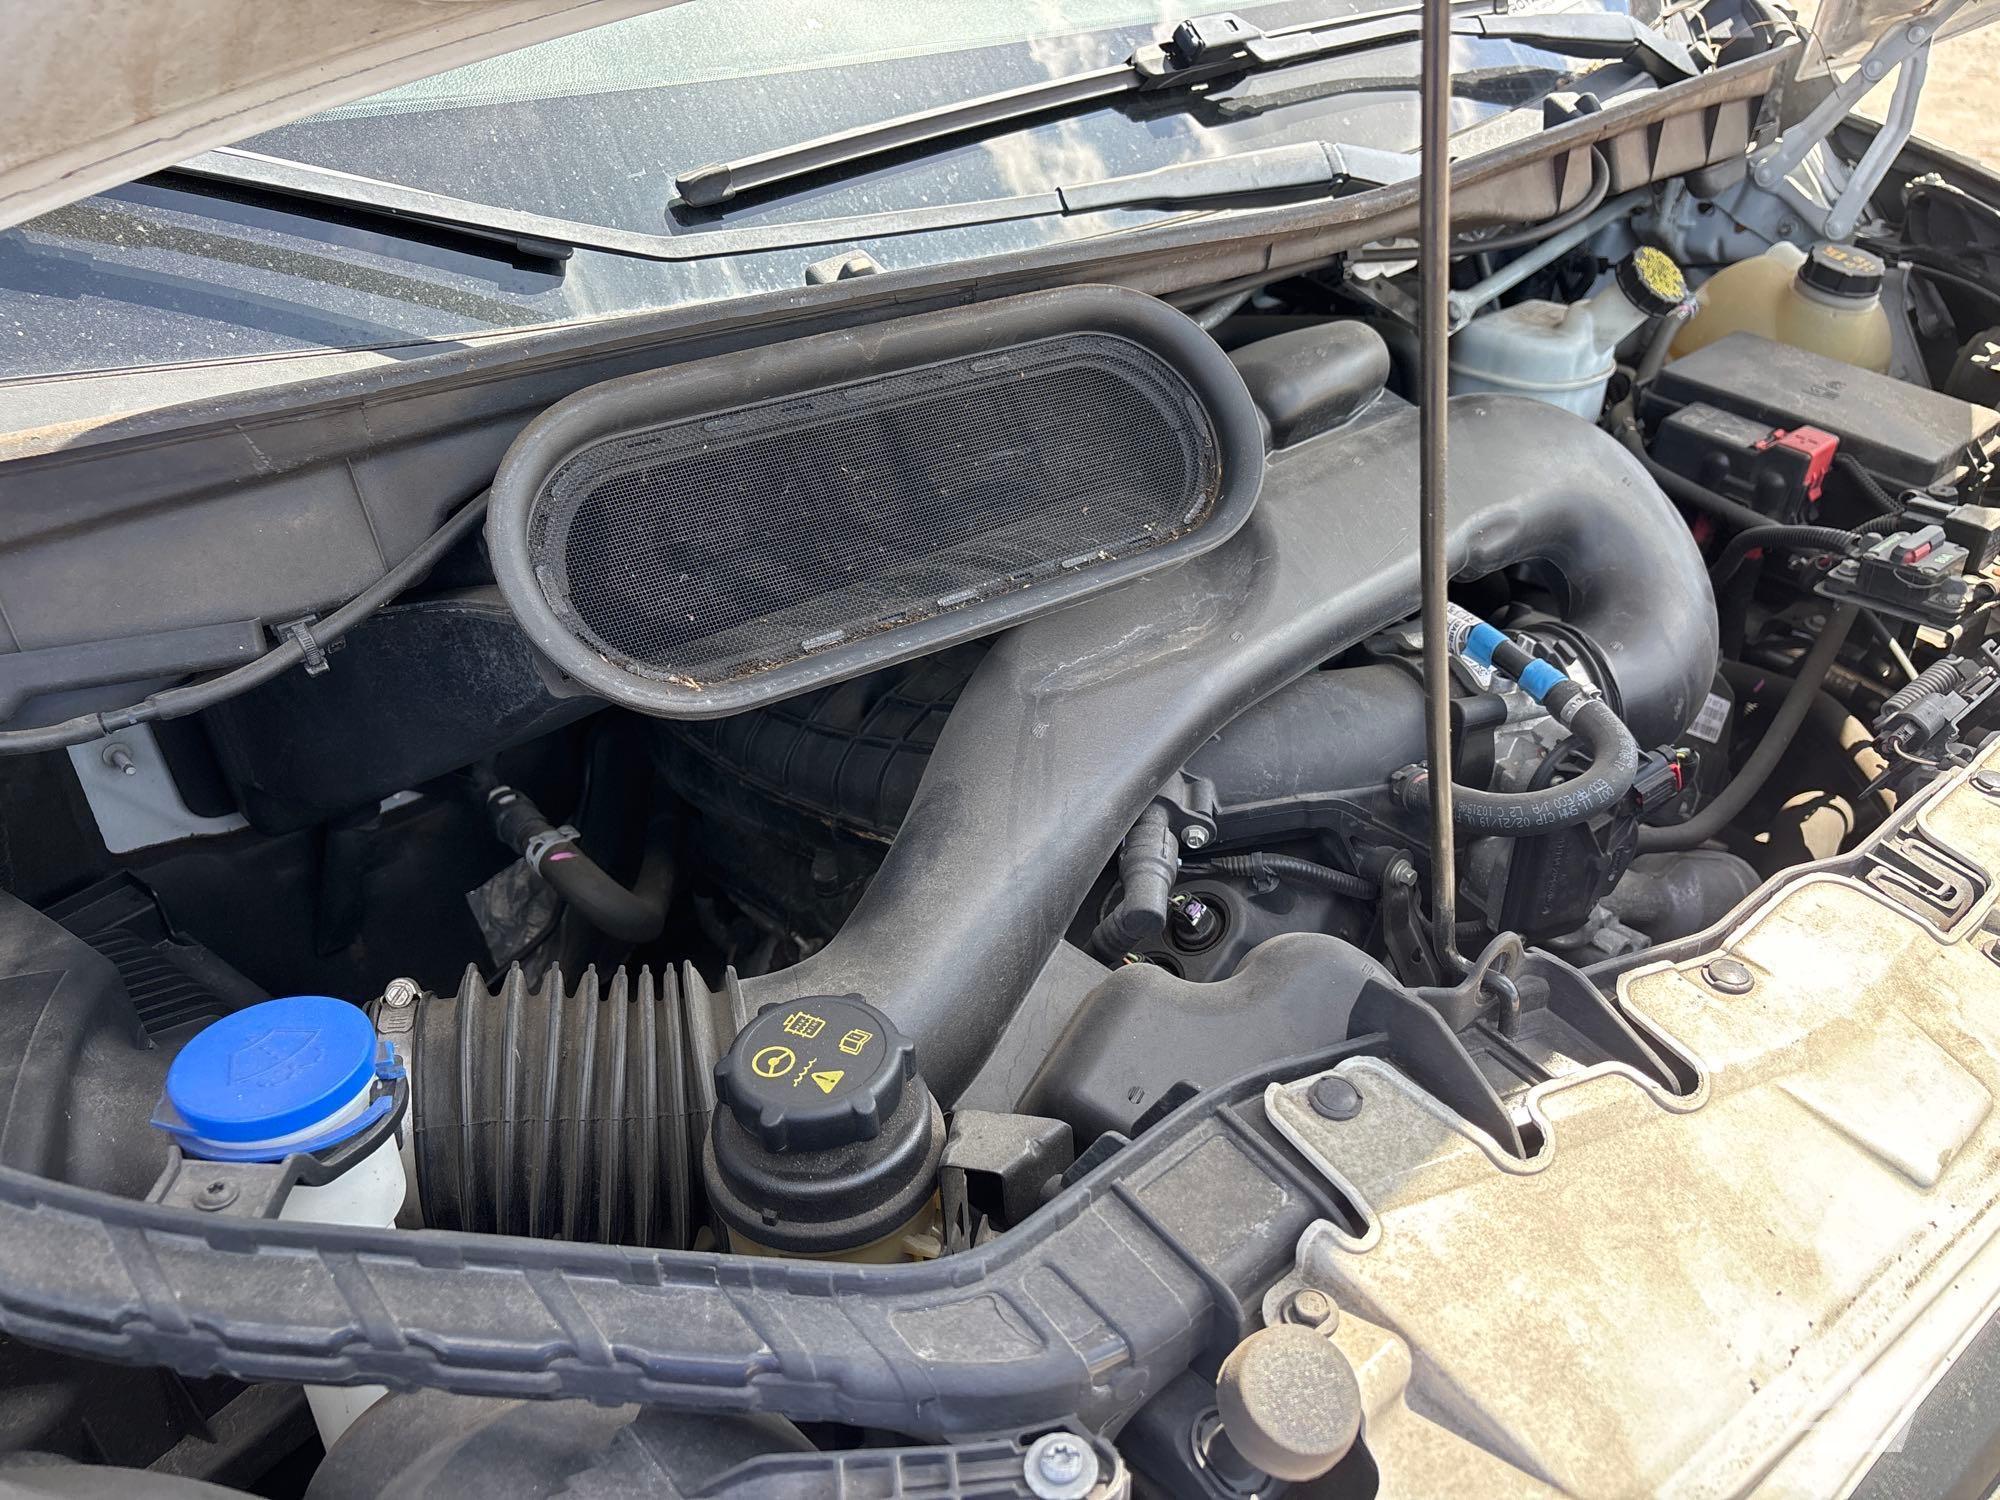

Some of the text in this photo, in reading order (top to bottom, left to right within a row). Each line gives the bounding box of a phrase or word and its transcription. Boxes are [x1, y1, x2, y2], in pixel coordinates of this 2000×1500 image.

[1599, 787, 1615, 804] DOT
[1479, 816, 1531, 829] 02/21/19
[1535, 812, 1555, 826] CIP
